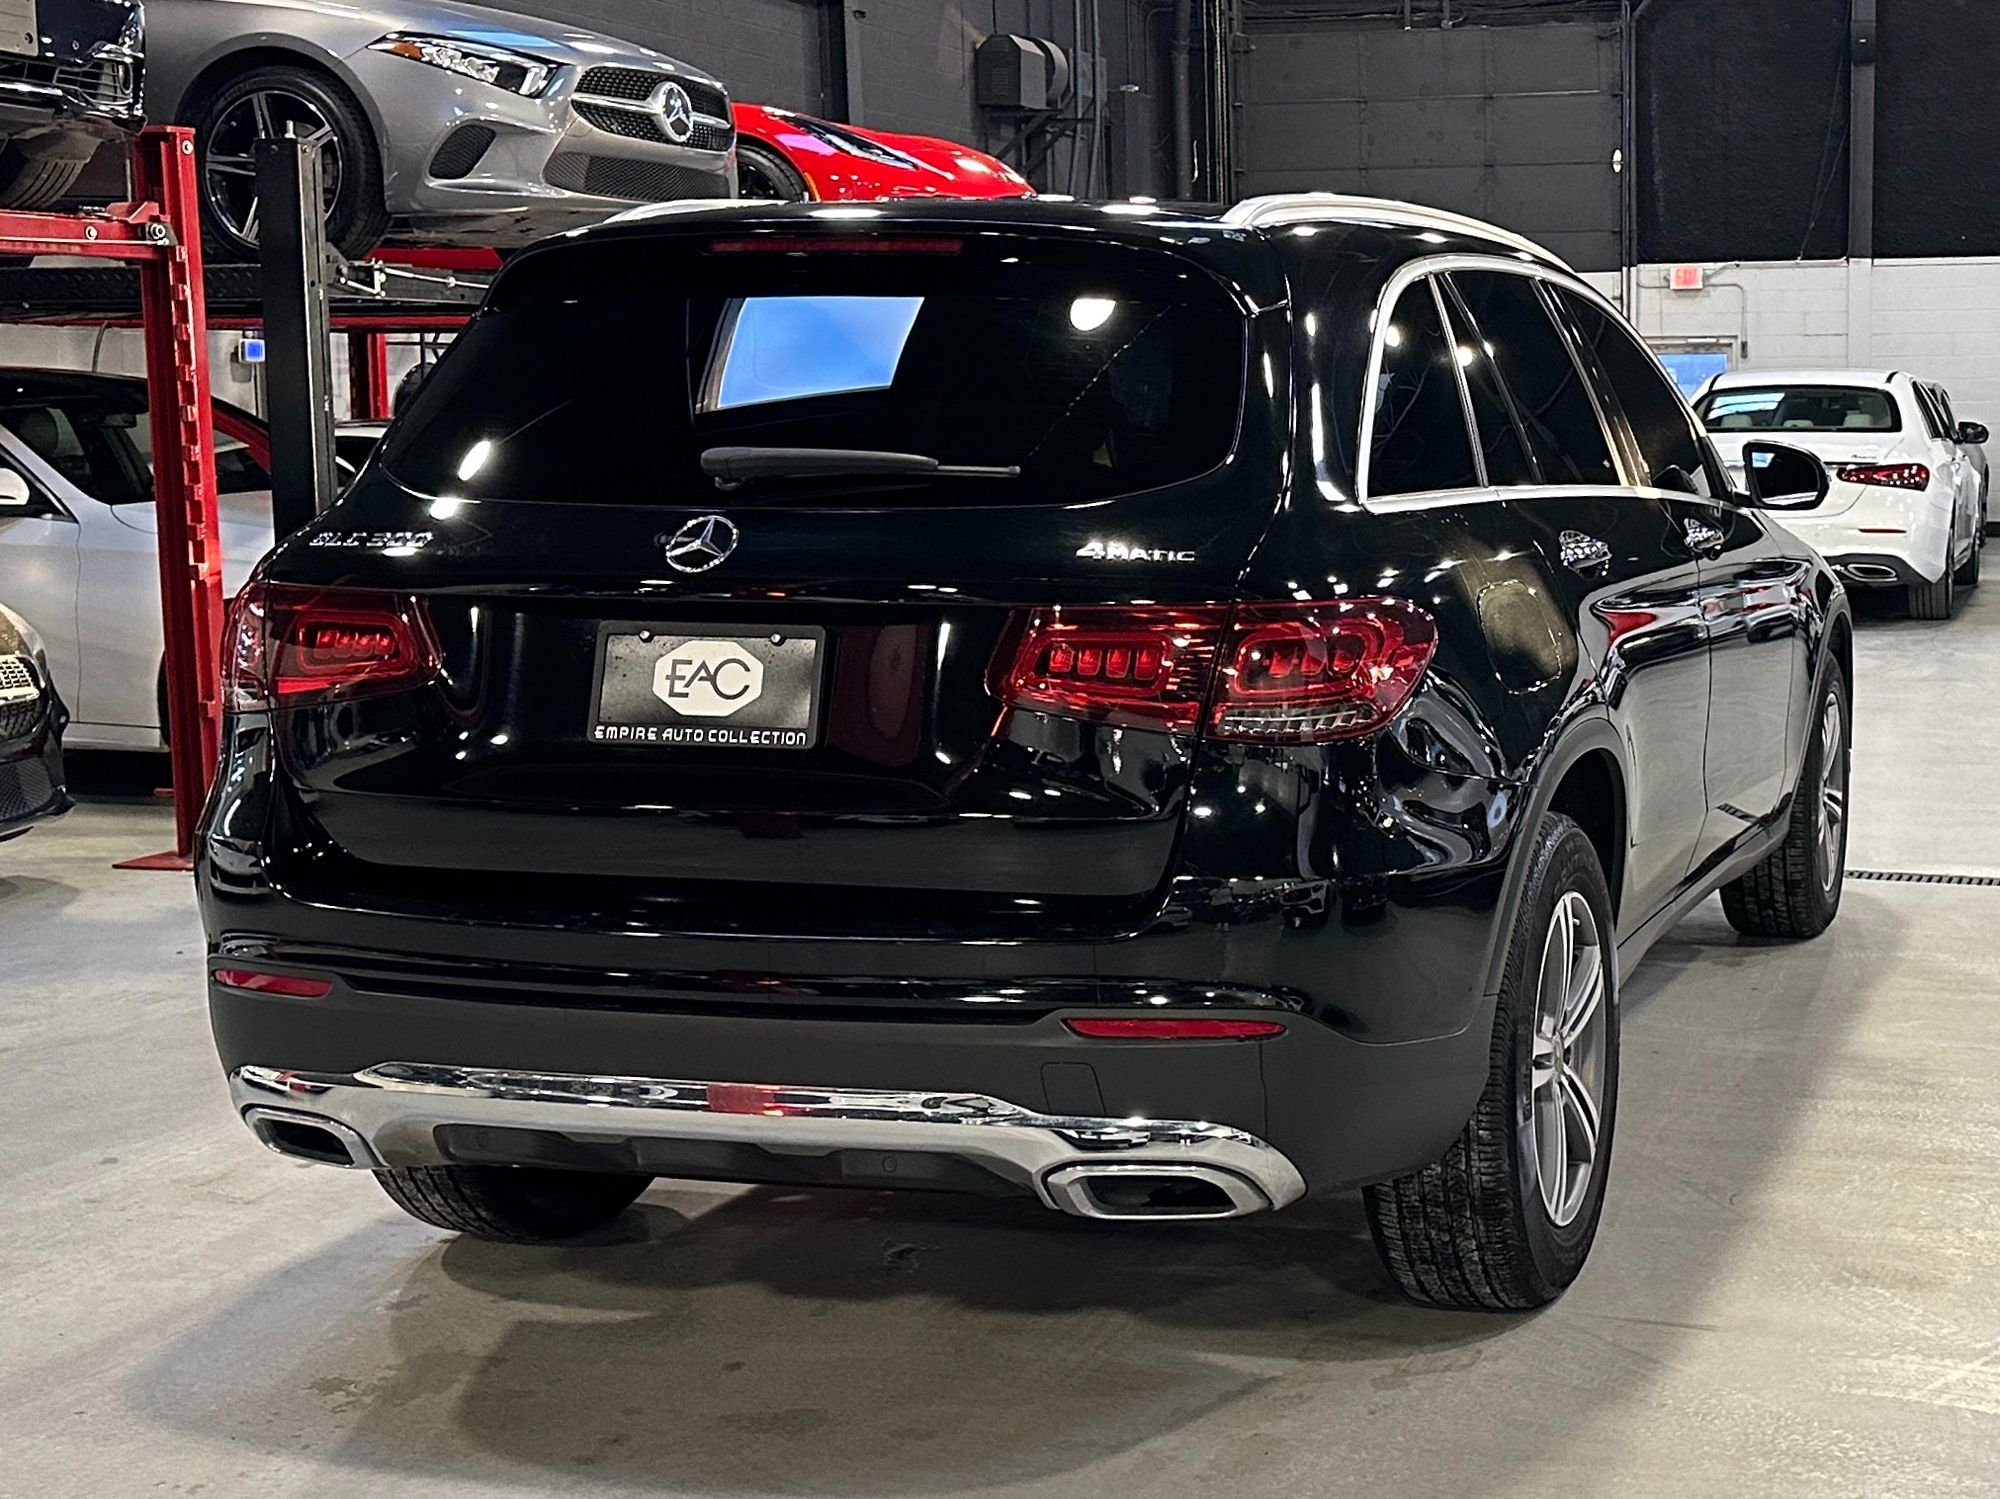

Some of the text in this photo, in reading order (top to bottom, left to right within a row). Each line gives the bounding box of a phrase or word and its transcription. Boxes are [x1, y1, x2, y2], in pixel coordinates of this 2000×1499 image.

[1076, 541, 1195, 561] 4MATIC
[665, 658, 751, 700] EAC
[594, 725, 806, 745] EMPIRE AUTO COLLECTION
